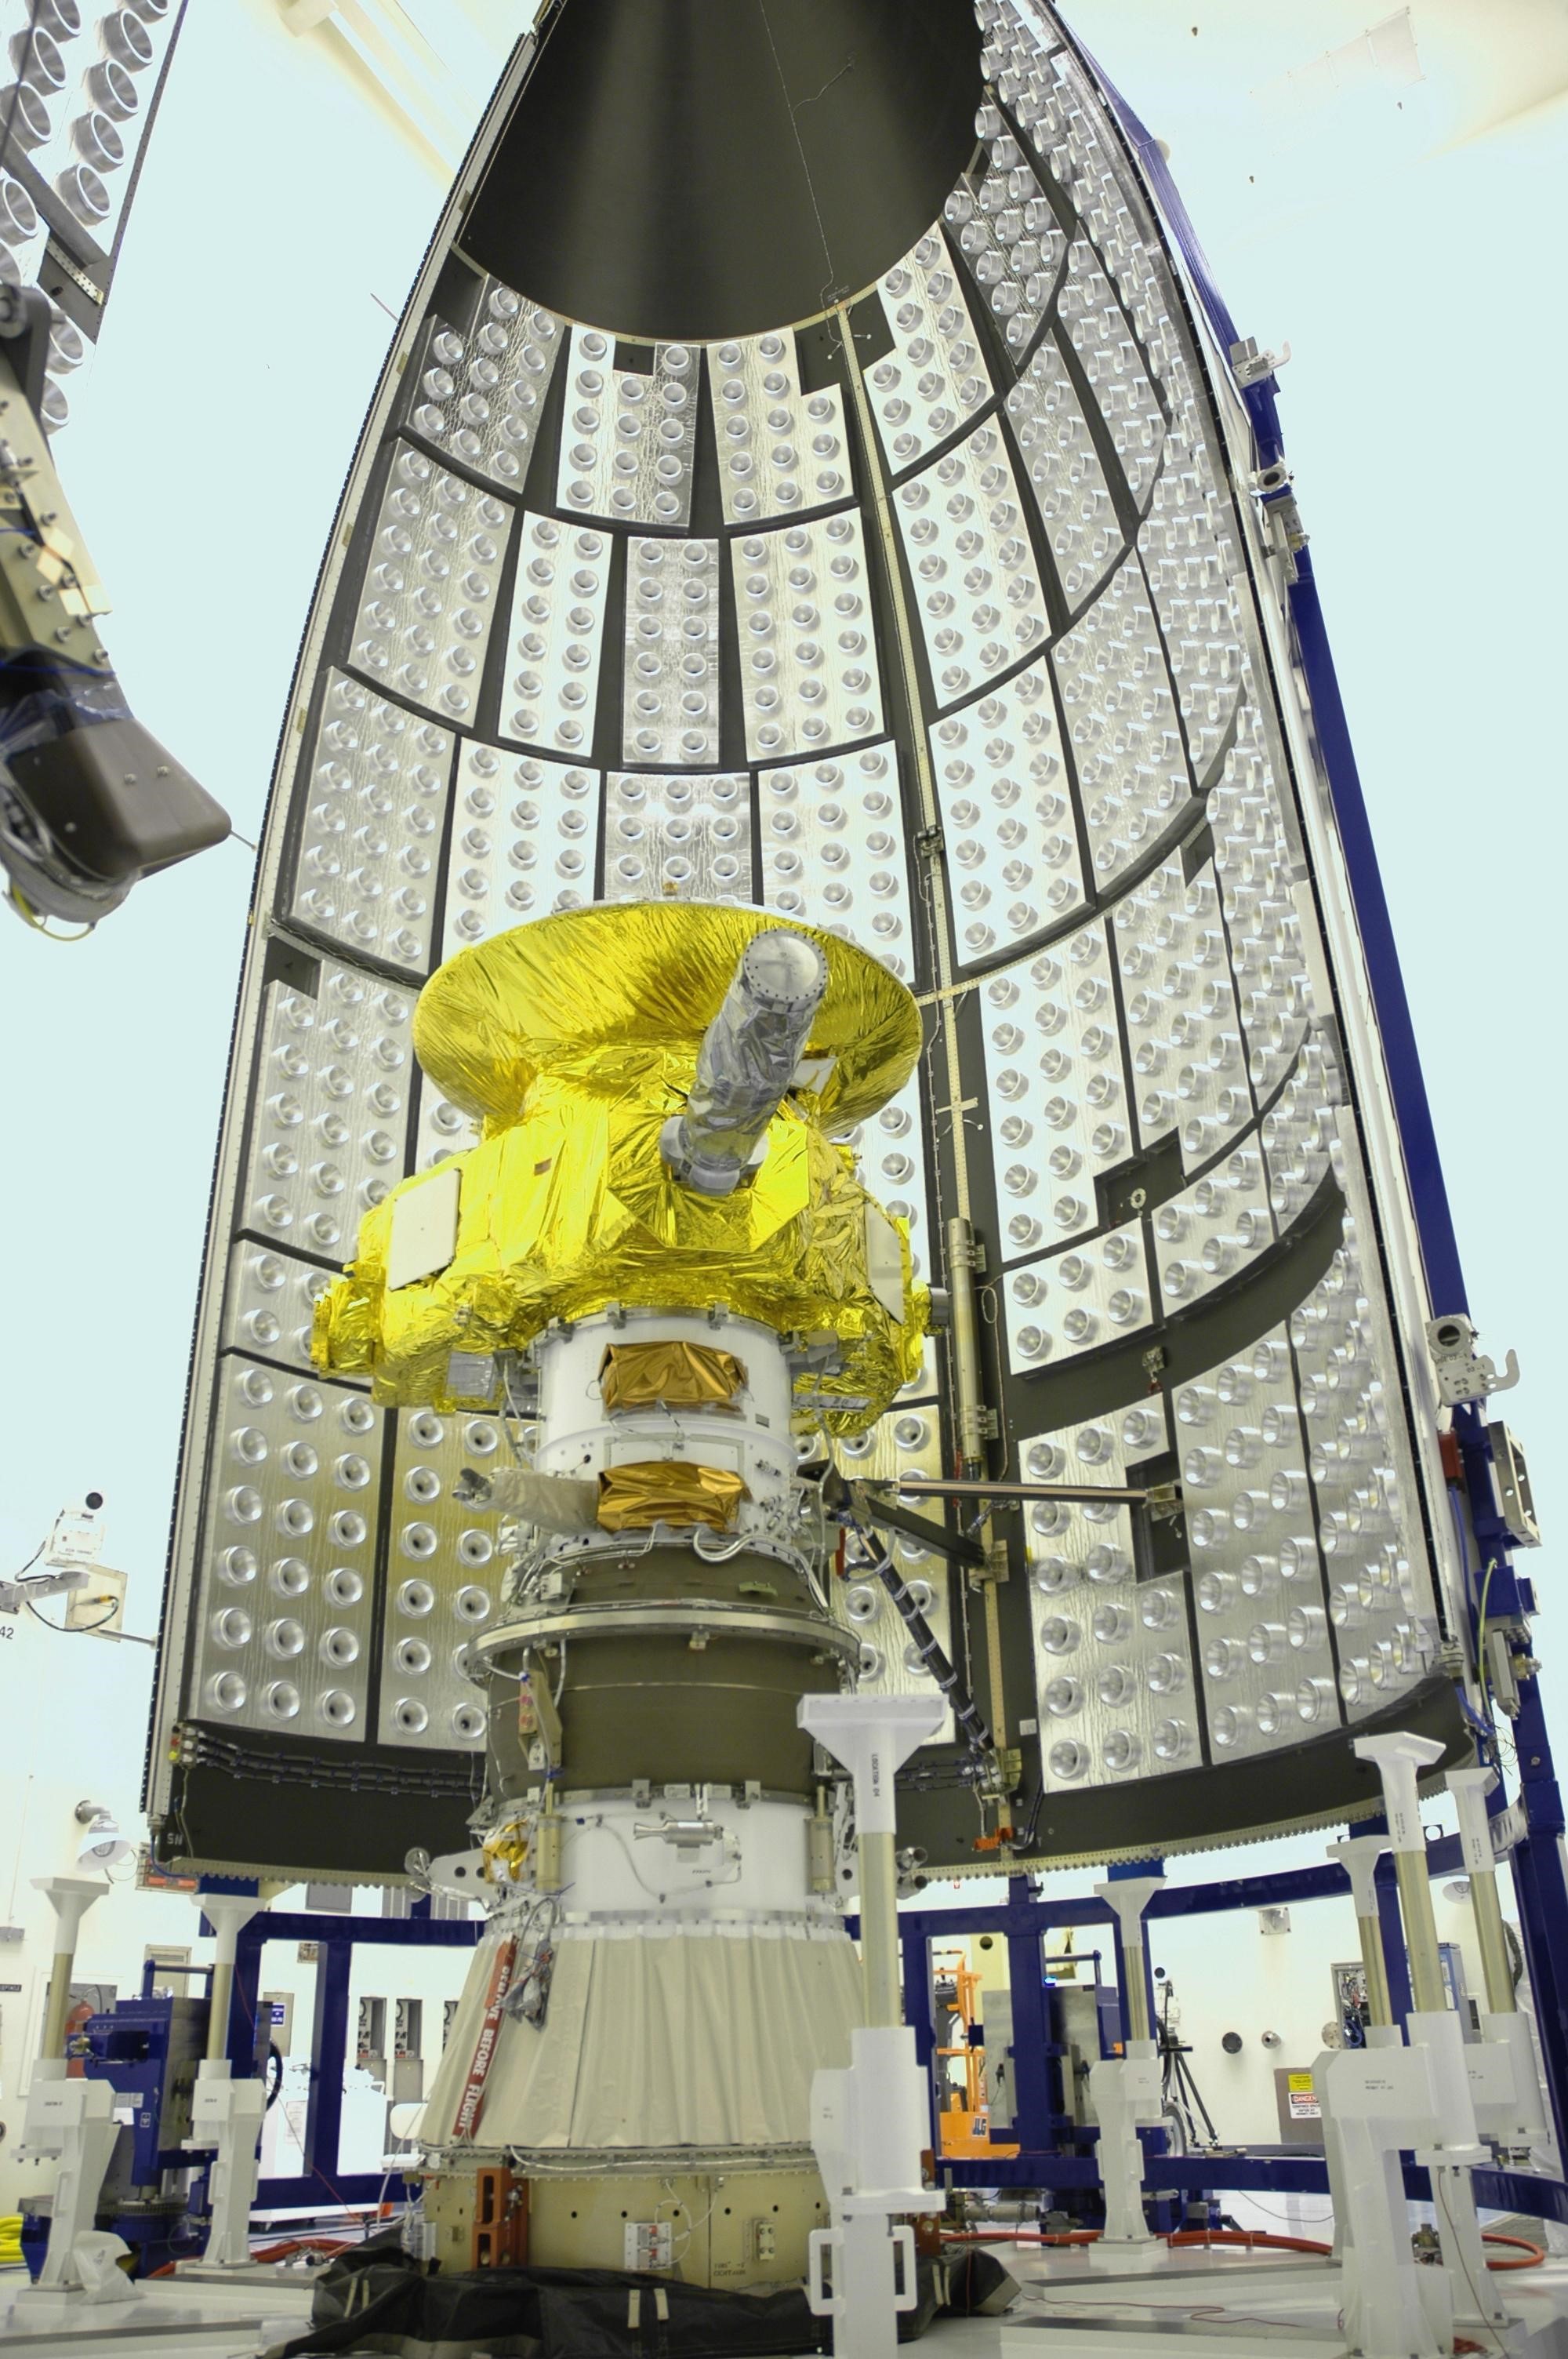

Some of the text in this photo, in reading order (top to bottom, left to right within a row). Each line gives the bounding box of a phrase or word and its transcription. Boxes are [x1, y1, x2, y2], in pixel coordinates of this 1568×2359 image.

[472, 2029, 495, 2077] BEFORE
[458, 2084, 481, 2128] FLIGHT
[972, 2117, 987, 2135] JLG
